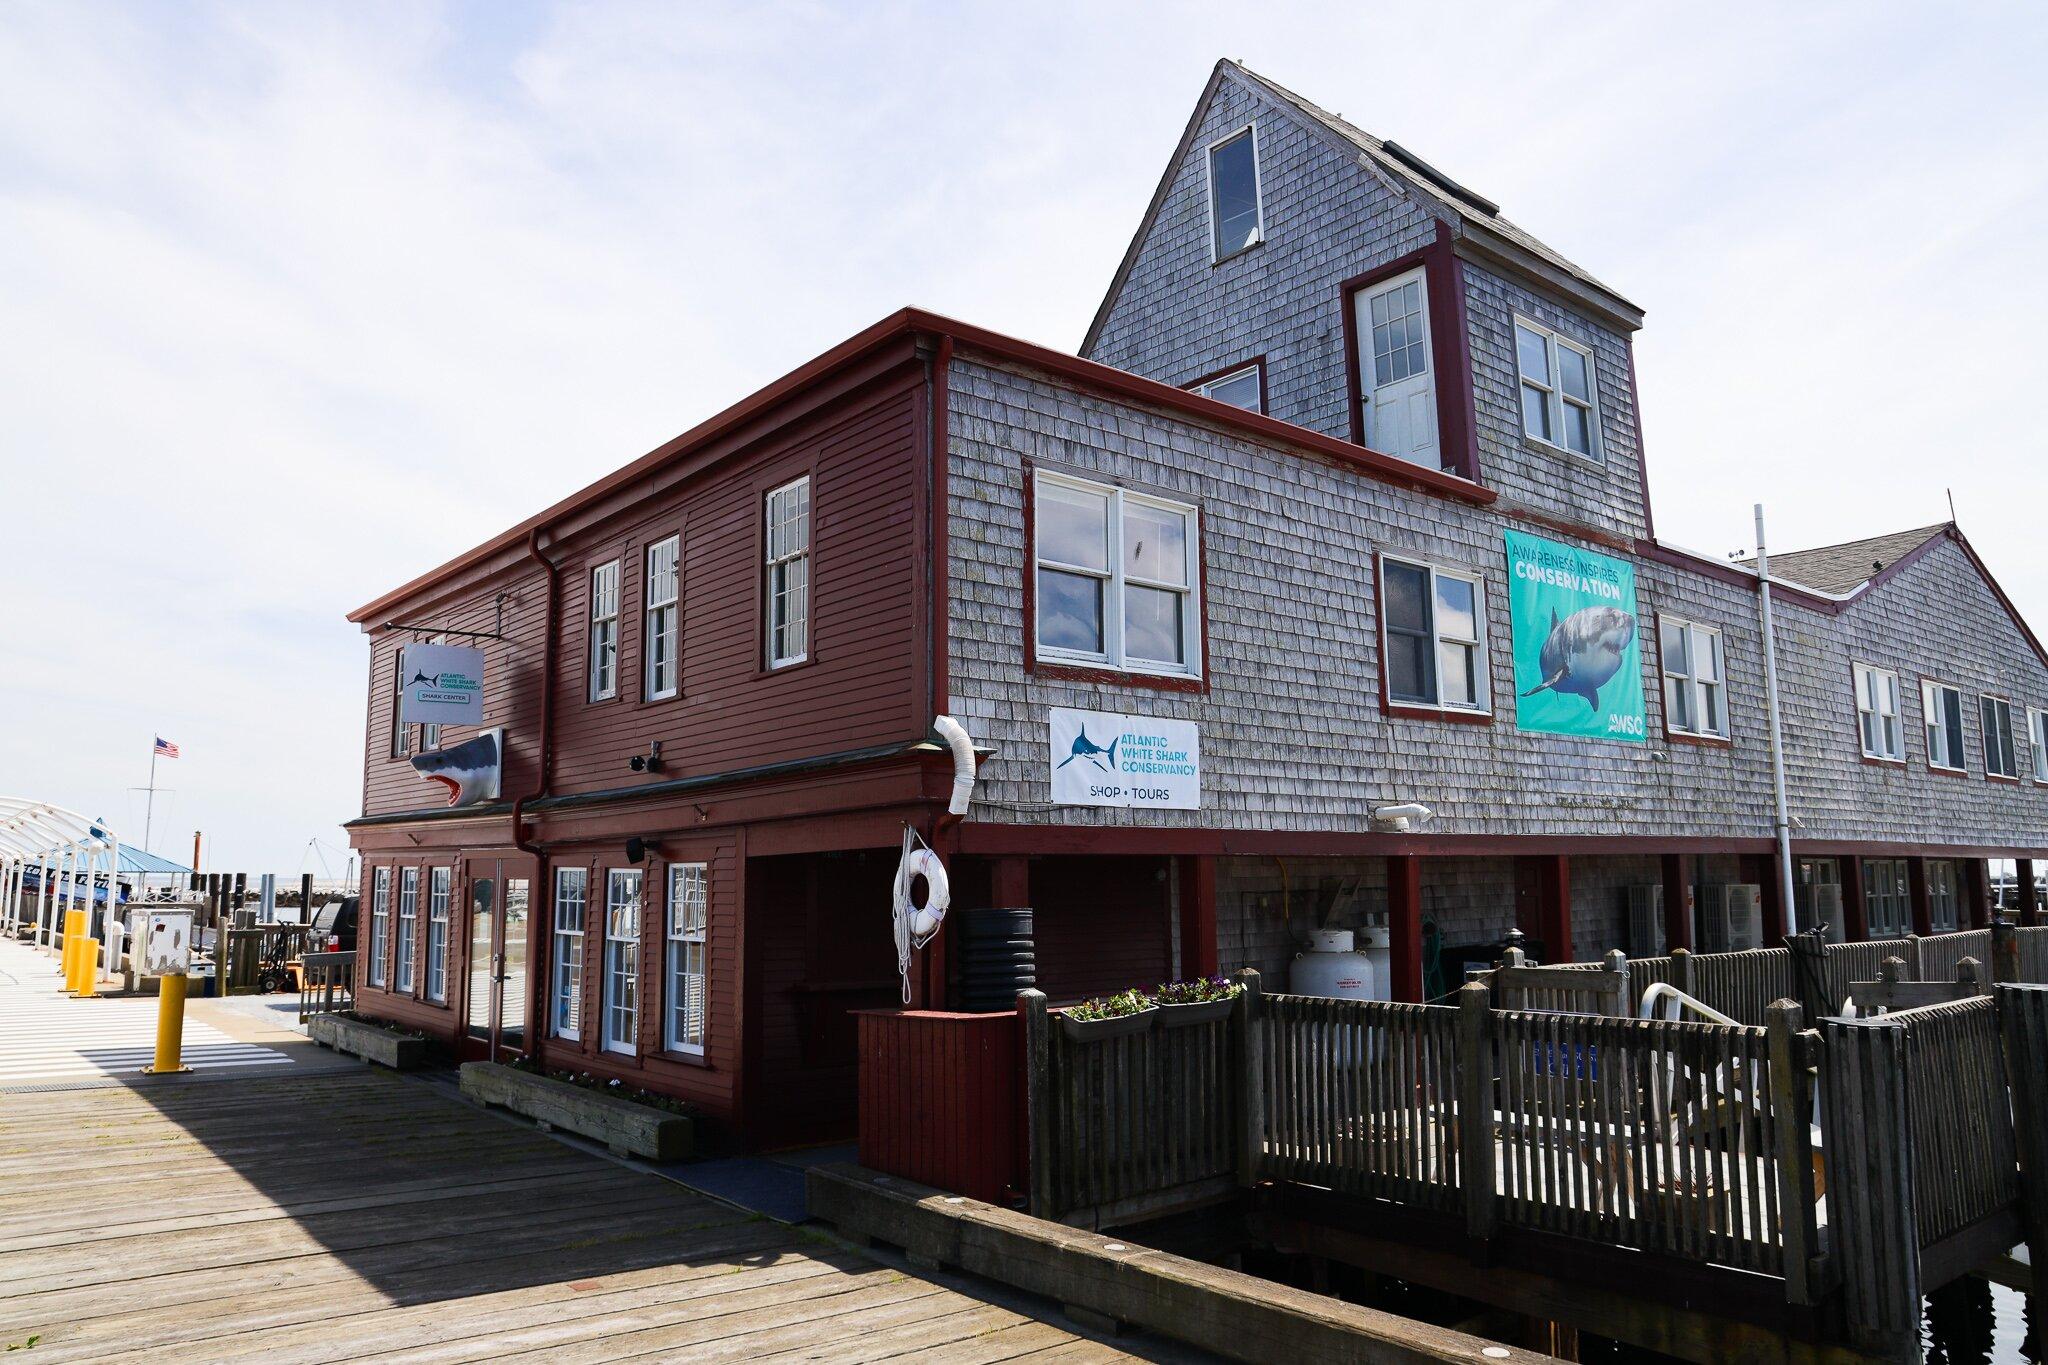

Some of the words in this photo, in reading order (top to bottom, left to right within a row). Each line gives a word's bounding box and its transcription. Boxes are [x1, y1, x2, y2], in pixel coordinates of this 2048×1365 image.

[1512, 544, 1576, 573] AWARENESS
[1577, 561, 1619, 583] INSPIRES
[1515, 560, 1621, 601] CONSERVATION
[1121, 734, 1168, 748] ATLANTIC
[1121, 748, 1153, 760] WHITE
[1156, 750, 1188, 762] SHARK
[1122, 761, 1196, 776] CONSERVANCY
[1090, 785, 1121, 798] SHOP
[1131, 787, 1170, 800] TOURS
